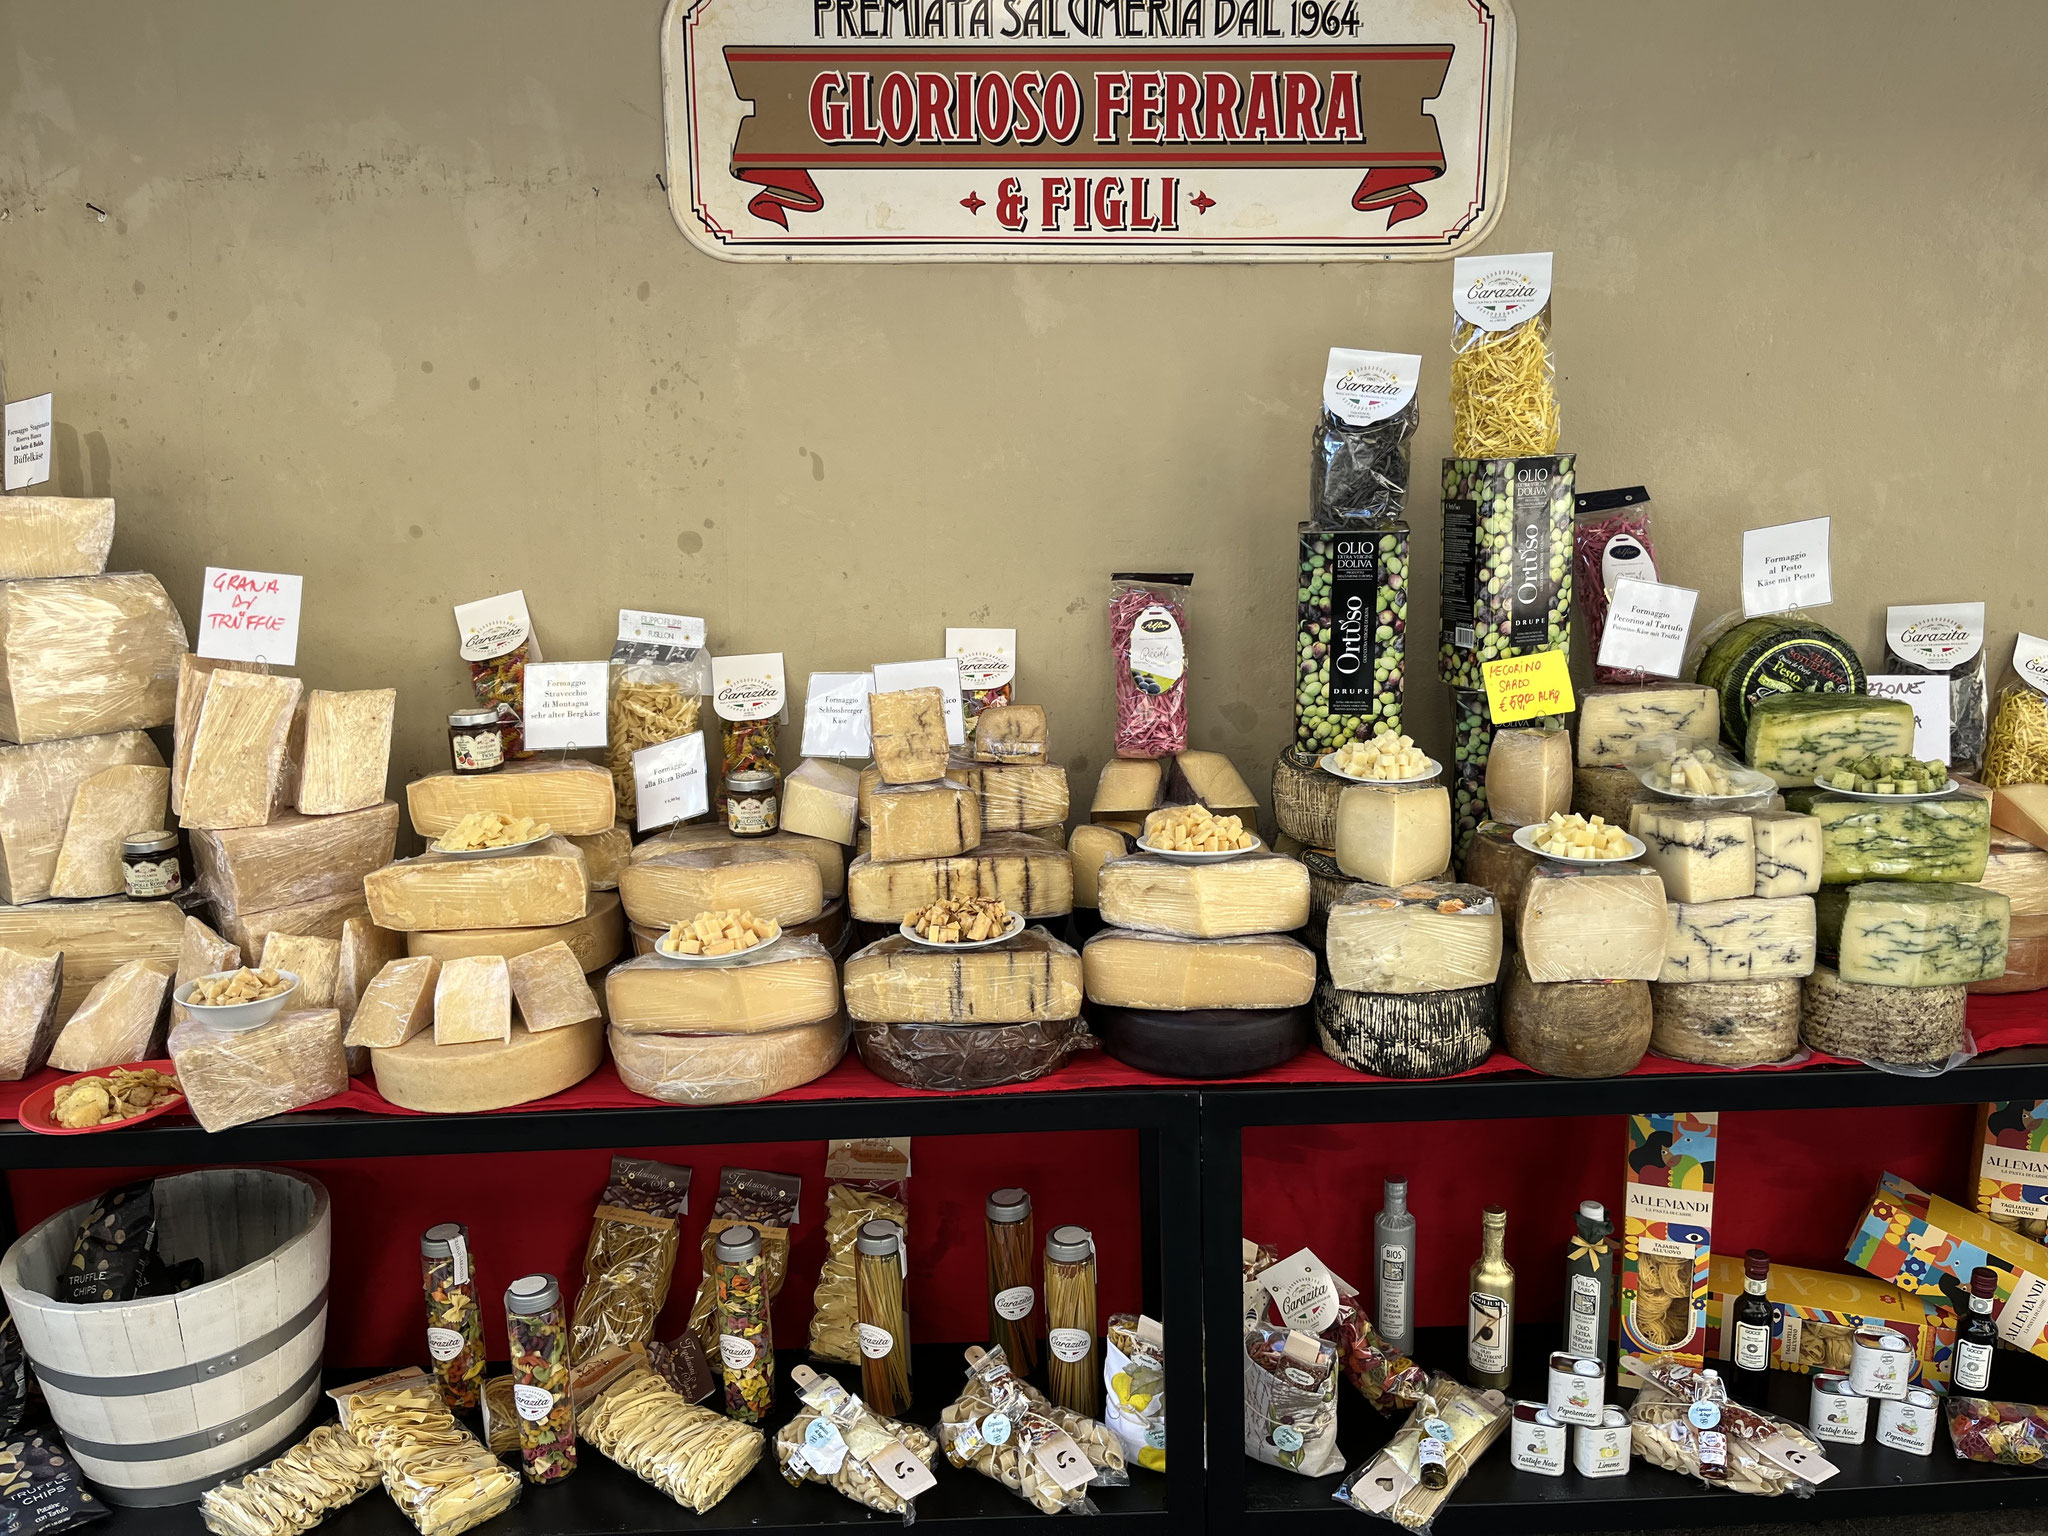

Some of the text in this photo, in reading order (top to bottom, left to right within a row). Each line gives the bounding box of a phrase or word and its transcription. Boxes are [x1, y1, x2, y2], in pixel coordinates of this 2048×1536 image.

[813, 0, 1363, 39] PREMIATA SALUMERIA DAL 1964
[809, 70, 1365, 145] GLORIOSO FERRARA
[997, 177, 1178, 232] & FIGLI
[1467, 282, 1538, 300] Carazita
[1336, 376, 1401, 396] Carazita
[1518, 468, 1548, 482] OLIO
[1518, 487, 1546, 496] D'OLIVA
[1338, 542, 1374, 554] OLIO
[1338, 560, 1372, 568] D'OLIVA
[1765, 552, 1806, 564] Formaggio
[1781, 564, 1802, 572] Pesto
[213, 572, 280, 594] GRANA
[1758, 580, 1776, 588] Käse
[1794, 573, 1815, 581] Pesto
[1631, 605, 1670, 619] Formaggio
[1515, 618, 1546, 626] DRUPE
[1614, 614, 1644, 625] Pecorino
[1655, 620, 1683, 632] Tartufo
[466, 628, 524, 648] Carazita
[1901, 629, 1970, 643] Carazita
[1772, 660, 1800, 683] Pesto
[547, 680, 586, 688] Formaggio
[1499, 678, 1530, 694] SARDO
[544, 690, 588, 698] Stravecchio
[718, 688, 779, 701] Carazita
[825, 696, 858, 704] Formaggio
[552, 700, 588, 708] Montagna
[567, 710, 600, 719] Bergkäse
[654, 760, 687, 776] Formaggio
[645, 780, 656, 788] alla
[1630, 1194, 1709, 1213] ALLEMANDI
[2001, 1202, 2039, 1212] TAGLIATELLE
[1654, 1242, 1680, 1250] TAJARIN
[1386, 1250, 1402, 1260] BIOS
[69, 1271, 108, 1286] TRUFFLE
[73, 1284, 97, 1298] CHIPS
[997, 1294, 1032, 1308] Carazita
[1282, 1284, 1328, 1315] Carazita
[1474, 1296, 1500, 1307] DOLIUM
[2006, 1280, 2046, 1340] ALLEMANDI
[1573, 1335, 1593, 1344] VERGINE
[1576, 1330, 1590, 1338] EXTRA
[1050, 1336, 1088, 1348] Carazita
[1874, 1382, 1894, 1392] Aglio
[1557, 1406, 1597, 1418] Peperoncino
[1817, 1424, 1841, 1435] Tartufo
[1841, 1428, 1858, 1436] Nero
[1885, 1431, 1926, 1448] Peperoncino
[1518, 1454, 1542, 1466] Tartufo
[1542, 1459, 1558, 1468] Nero
[1598, 1461, 1620, 1469] Limone
[10, 1475, 72, 1500] TRUFFLE
[22, 1486, 66, 1506] CHIPS
[36, 1502, 60, 1514] Patatine
[48, 1506, 69, 1518] Tartufo
